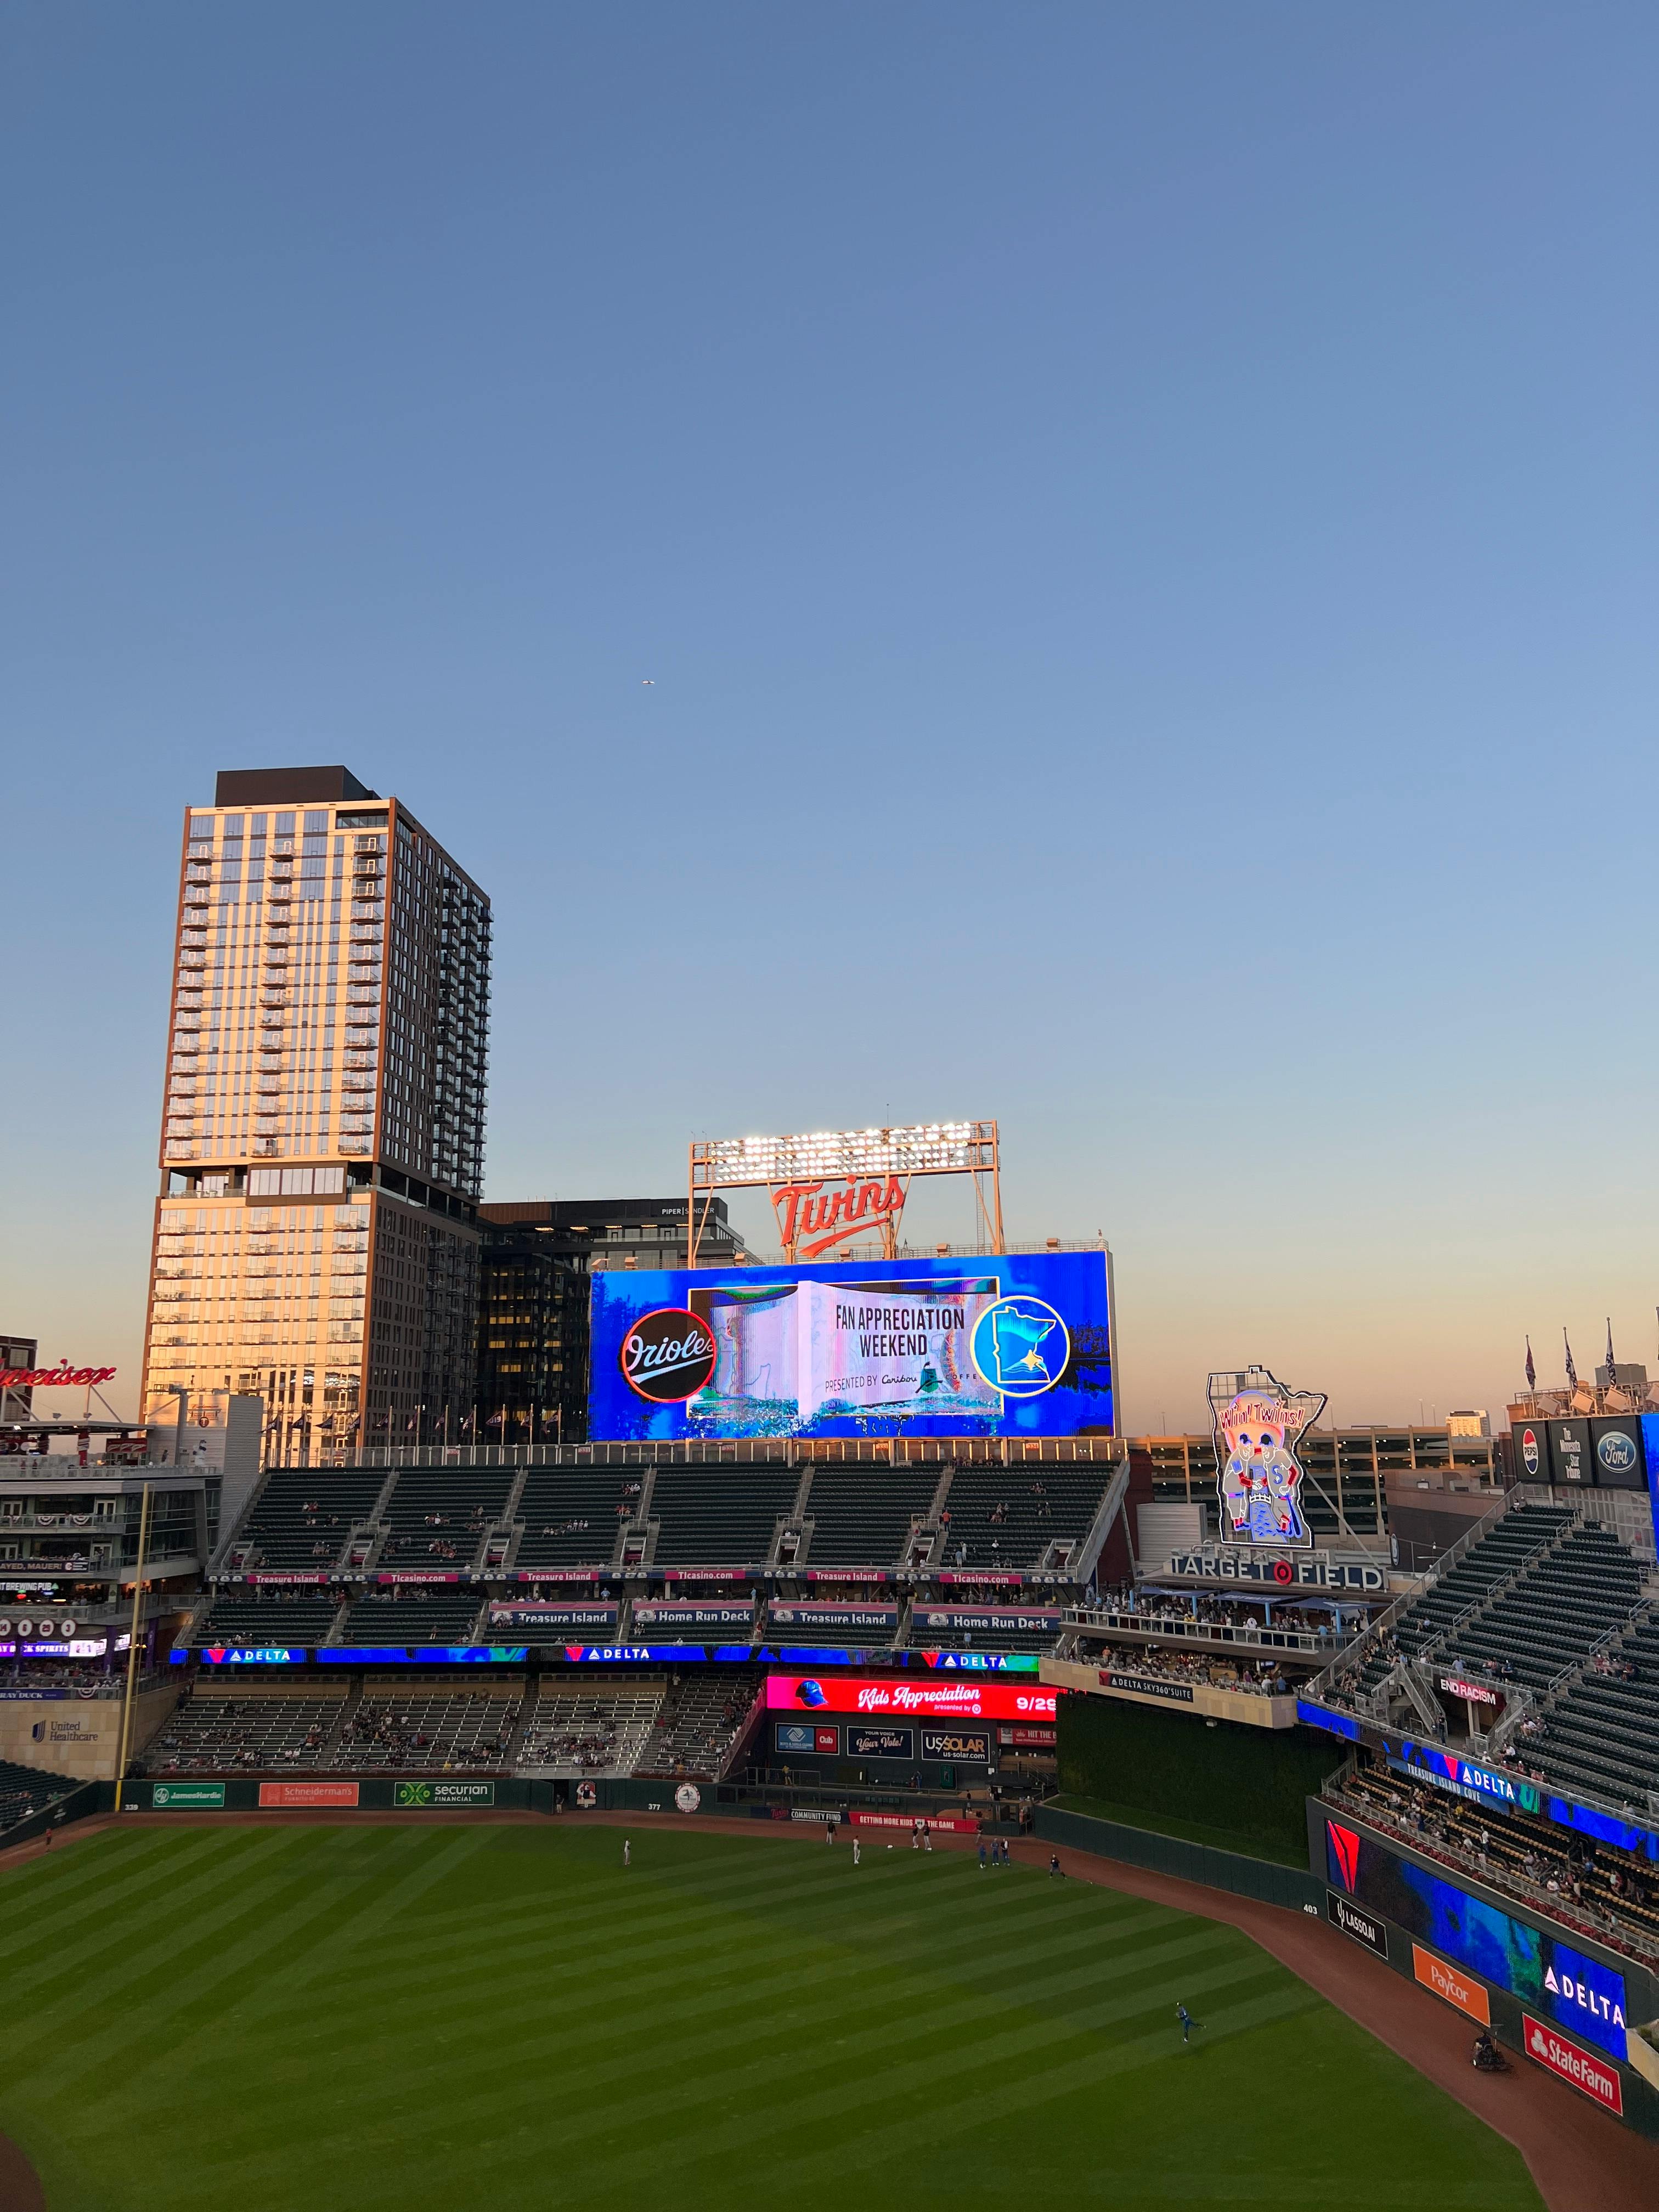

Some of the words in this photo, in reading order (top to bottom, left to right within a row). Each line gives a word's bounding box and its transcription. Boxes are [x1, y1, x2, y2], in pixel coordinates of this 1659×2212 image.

[772, 1174, 904, 1246] Twins
[837, 1305, 855, 1330] FAN
[858, 1307, 964, 1330] APPRECIATION
[625, 1330, 713, 1372] Orioles
[860, 1334, 927, 1357] WEEKEND
[0, 1358, 117, 1386] weiser
[825, 1376, 865, 1392] PRESENTED
[867, 1375, 877, 1386] BY
[882, 1375, 917, 1384] Caribou
[1220, 1404, 1251, 1430] Win!
[1254, 1402, 1304, 1426] Twins!
[1605, 1438, 1628, 1464] Ford
[816, 1572, 851, 1581] Treasure
[853, 1572, 877, 1580] Island
[1171, 1556, 1269, 1581] TARGET
[1298, 1564, 1383, 1589] FIELD
[5, 1582, 37, 1590] BREWING
[38, 1582, 52, 1590] PUB
[518, 1612, 568, 1623] Treasure
[572, 1611, 607, 1622] Island
[659, 1611, 693, 1622] Home
[696, 1610, 718, 1621] Run
[721, 1610, 750, 1621] Deck
[800, 1612, 849, 1623] Treasure
[852, 1613, 886, 1624] Island
[954, 1615, 988, 1627] Home
[992, 1617, 1014, 1628] Run
[1018, 1617, 1048, 1629] Deck
[245, 1650, 290, 1661] DELTA
[604, 1649, 650, 1659] DELTA
[961, 1656, 1007, 1667] DELTA
[1119, 1678, 1142, 1689] DELTA
[1171, 1688, 1190, 1699] SUITE
[1441, 1679, 1459, 1693] END
[1460, 1684, 1496, 1705] RACISM
[858, 1688, 889, 1711] Kids
[892, 1685, 981, 1708] Appreciation
[51, 1722, 80, 1730] United
[50, 1731, 98, 1741] Healthcare
[1028, 1730, 1038, 1738] HIT
[856, 1737, 878, 1752] Your
[881, 1735, 904, 1748] Vote!
[943, 1751, 985, 1759] us-solar.com
[1407, 1763, 1436, 1784] TREASURE
[1439, 1777, 1460, 1795] ISLAND
[1464, 1786, 1481, 1803] COVE
[1474, 1770, 1515, 1799] DELTA
[285, 1787, 352, 1796] Schneiderman's
[435, 1786, 488, 1795] securian
[791, 1811, 825, 1820] COMMUNITY
[883, 1817, 899, 1825] MORE
[1304, 1904, 1317, 1915] 403
[1431, 1965, 1468, 2002] Paycor
[1562, 1974, 1625, 2029] DELTA
